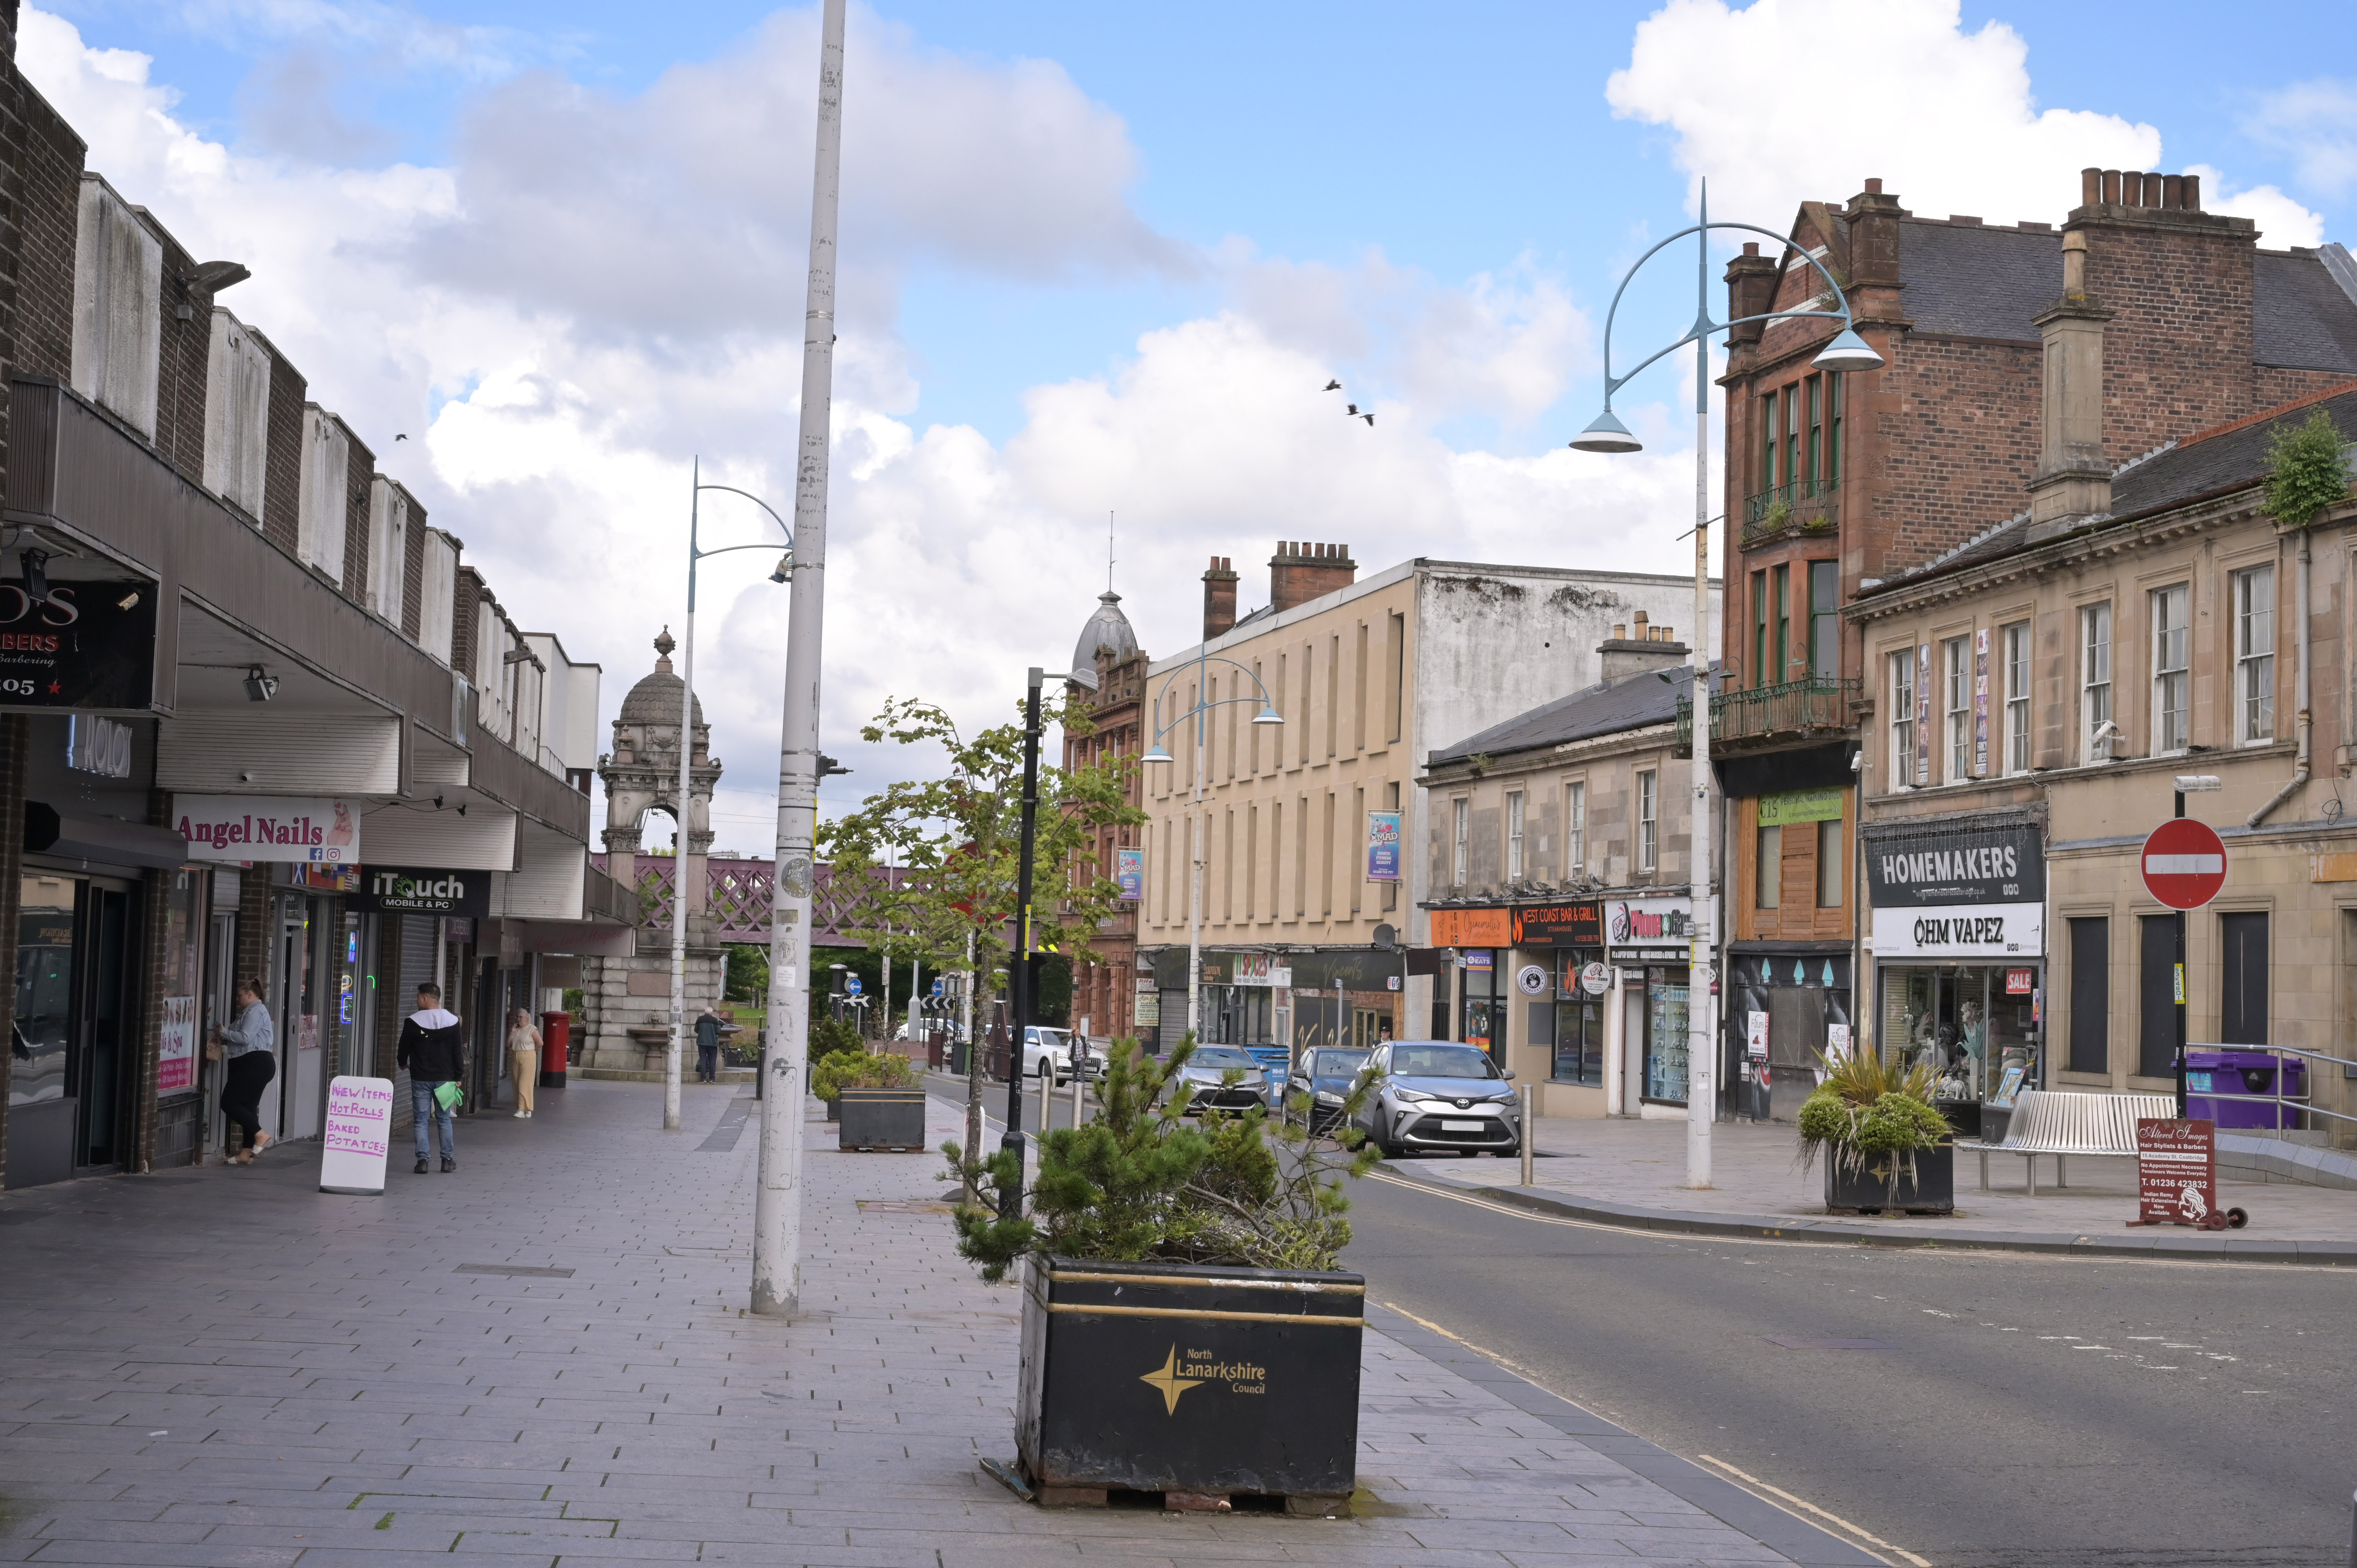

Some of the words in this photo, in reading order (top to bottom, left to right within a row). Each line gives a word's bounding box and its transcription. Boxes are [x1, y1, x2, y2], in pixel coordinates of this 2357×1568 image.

[0, 634, 59, 652] BERS
[0, 679, 34, 695] 05
[1977, 742, 1987, 752] FANCY
[1977, 753, 1987, 763] DRESS
[1760, 800, 1777, 818] C15
[1781, 796, 1804, 805] PERSONAL
[1805, 792, 1827, 803] TRAINING
[178, 815, 251, 849] Angel
[256, 817, 323, 845] Nails
[1376, 832, 1398, 842] MAD
[1882, 846, 2016, 884] HOMEMAKERS
[373, 872, 464, 898] iTouch
[386, 899, 424, 907] MOBILE
[1100, 917, 1113, 927] ALSTON
[1523, 909, 1539, 923] WEST
[1540, 908, 1559, 922] COAST
[1560, 908, 1573, 922] BAR
[1573, 907, 1578, 921] &
[1579, 907, 1597, 921] GRILL
[1631, 910, 1661, 937] Phone
[1663, 916, 1669, 929] &
[1671, 909, 1691, 936] Ga
[1953, 917, 2003, 943] VAPEZ
[589, 928, 622, 945] Hospice
[1523, 970, 1533, 980] ITALIAN
[1535, 970, 1544, 980] AROMA
[1623, 970, 1632, 978] 01236
[2008, 974, 2030, 989] SALE
[1751, 1019, 1764, 1029] Future
[168, 1032, 172, 1052] &
[173, 1031, 182, 1055] Spa
[1832, 1032, 1846, 1042] Future
[362, 1087, 392, 1101] ITEMS
[330, 1101, 350, 1113] HOT
[351, 1103, 383, 1117] ROLLS
[328, 1120, 360, 1134] BAKED
[2139, 1123, 2175, 1138] Altered
[2177, 1124, 2208, 1144] Images
[326, 1134, 386, 1153] POTATOES
[2151, 1179, 2175, 1187] 01236
[2177, 1180, 2207, 1188] 423832
[1187, 1349, 1212, 1359] North
[1177, 1360, 1265, 1381] Lanarkshire
[1233, 1382, 1265, 1393] Council
